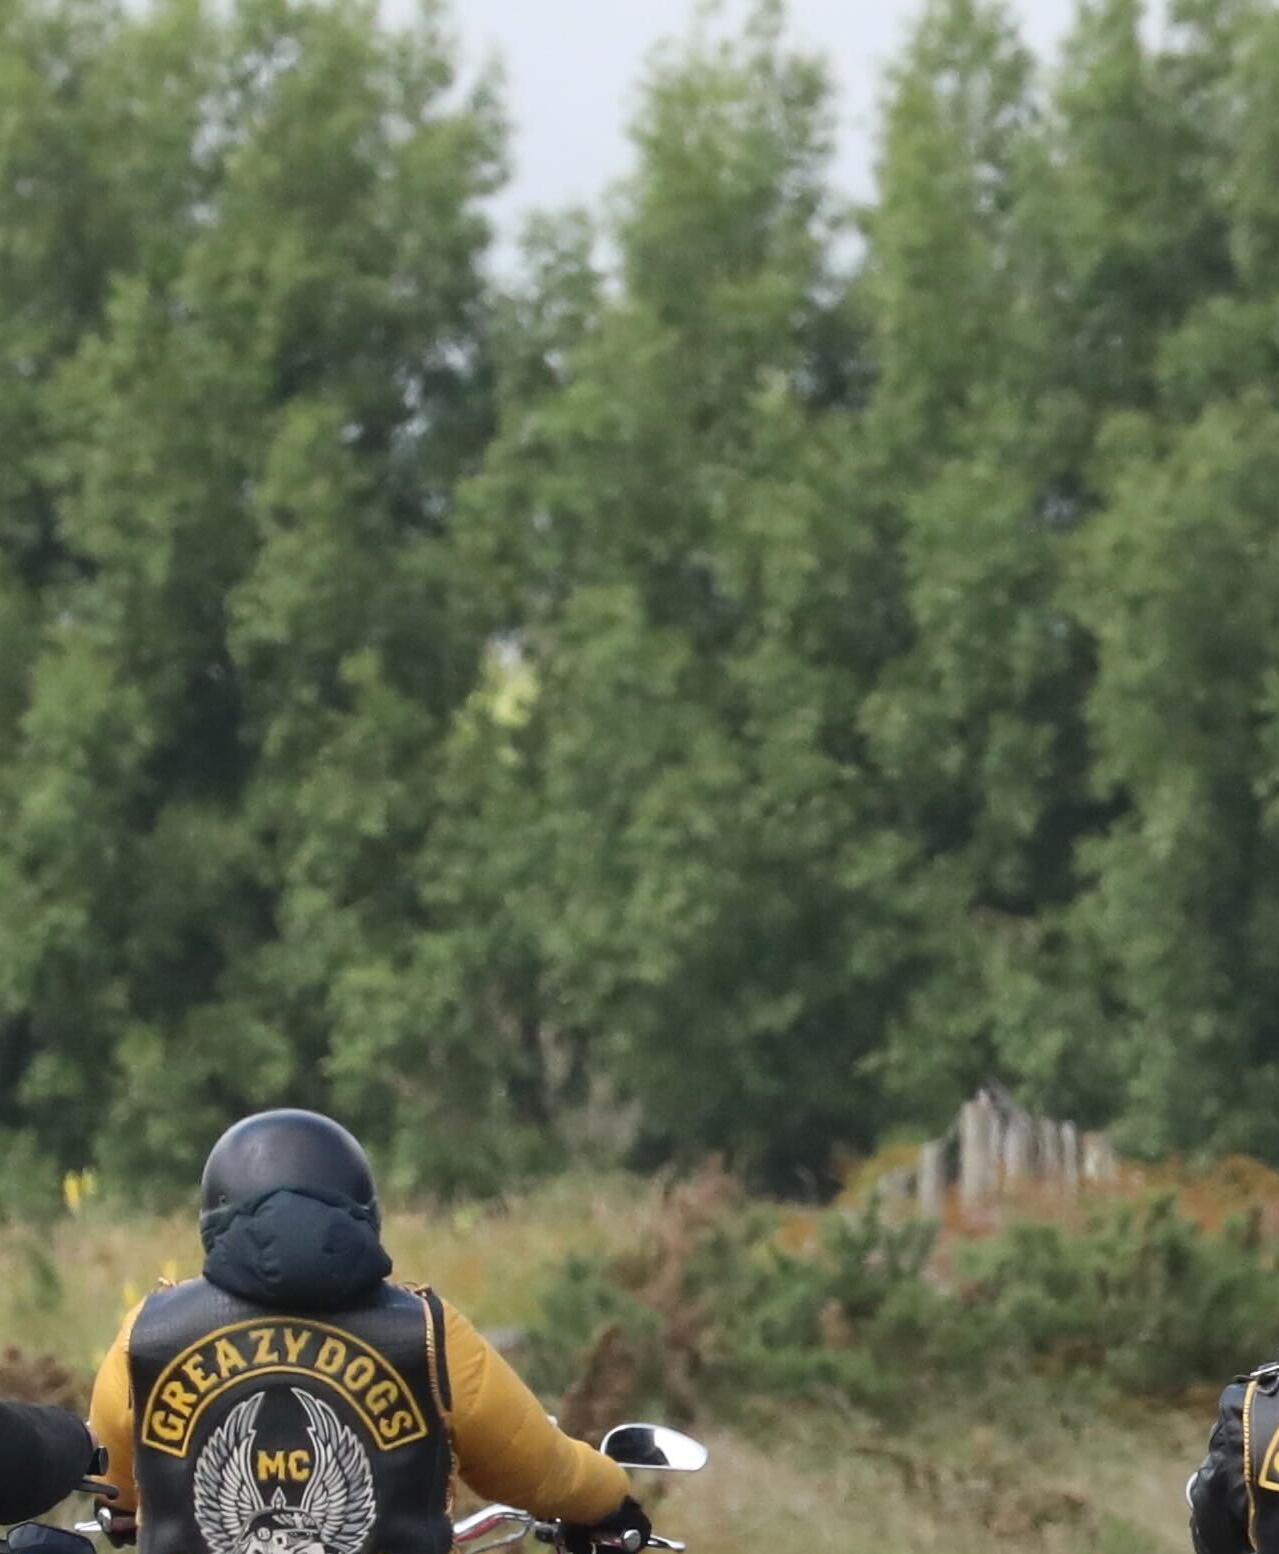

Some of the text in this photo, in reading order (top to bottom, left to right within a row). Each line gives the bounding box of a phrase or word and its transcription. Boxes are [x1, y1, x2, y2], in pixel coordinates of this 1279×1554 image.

[152, 1327, 414, 1441] GREAZY DOGS
[256, 1449, 312, 1483] MC
